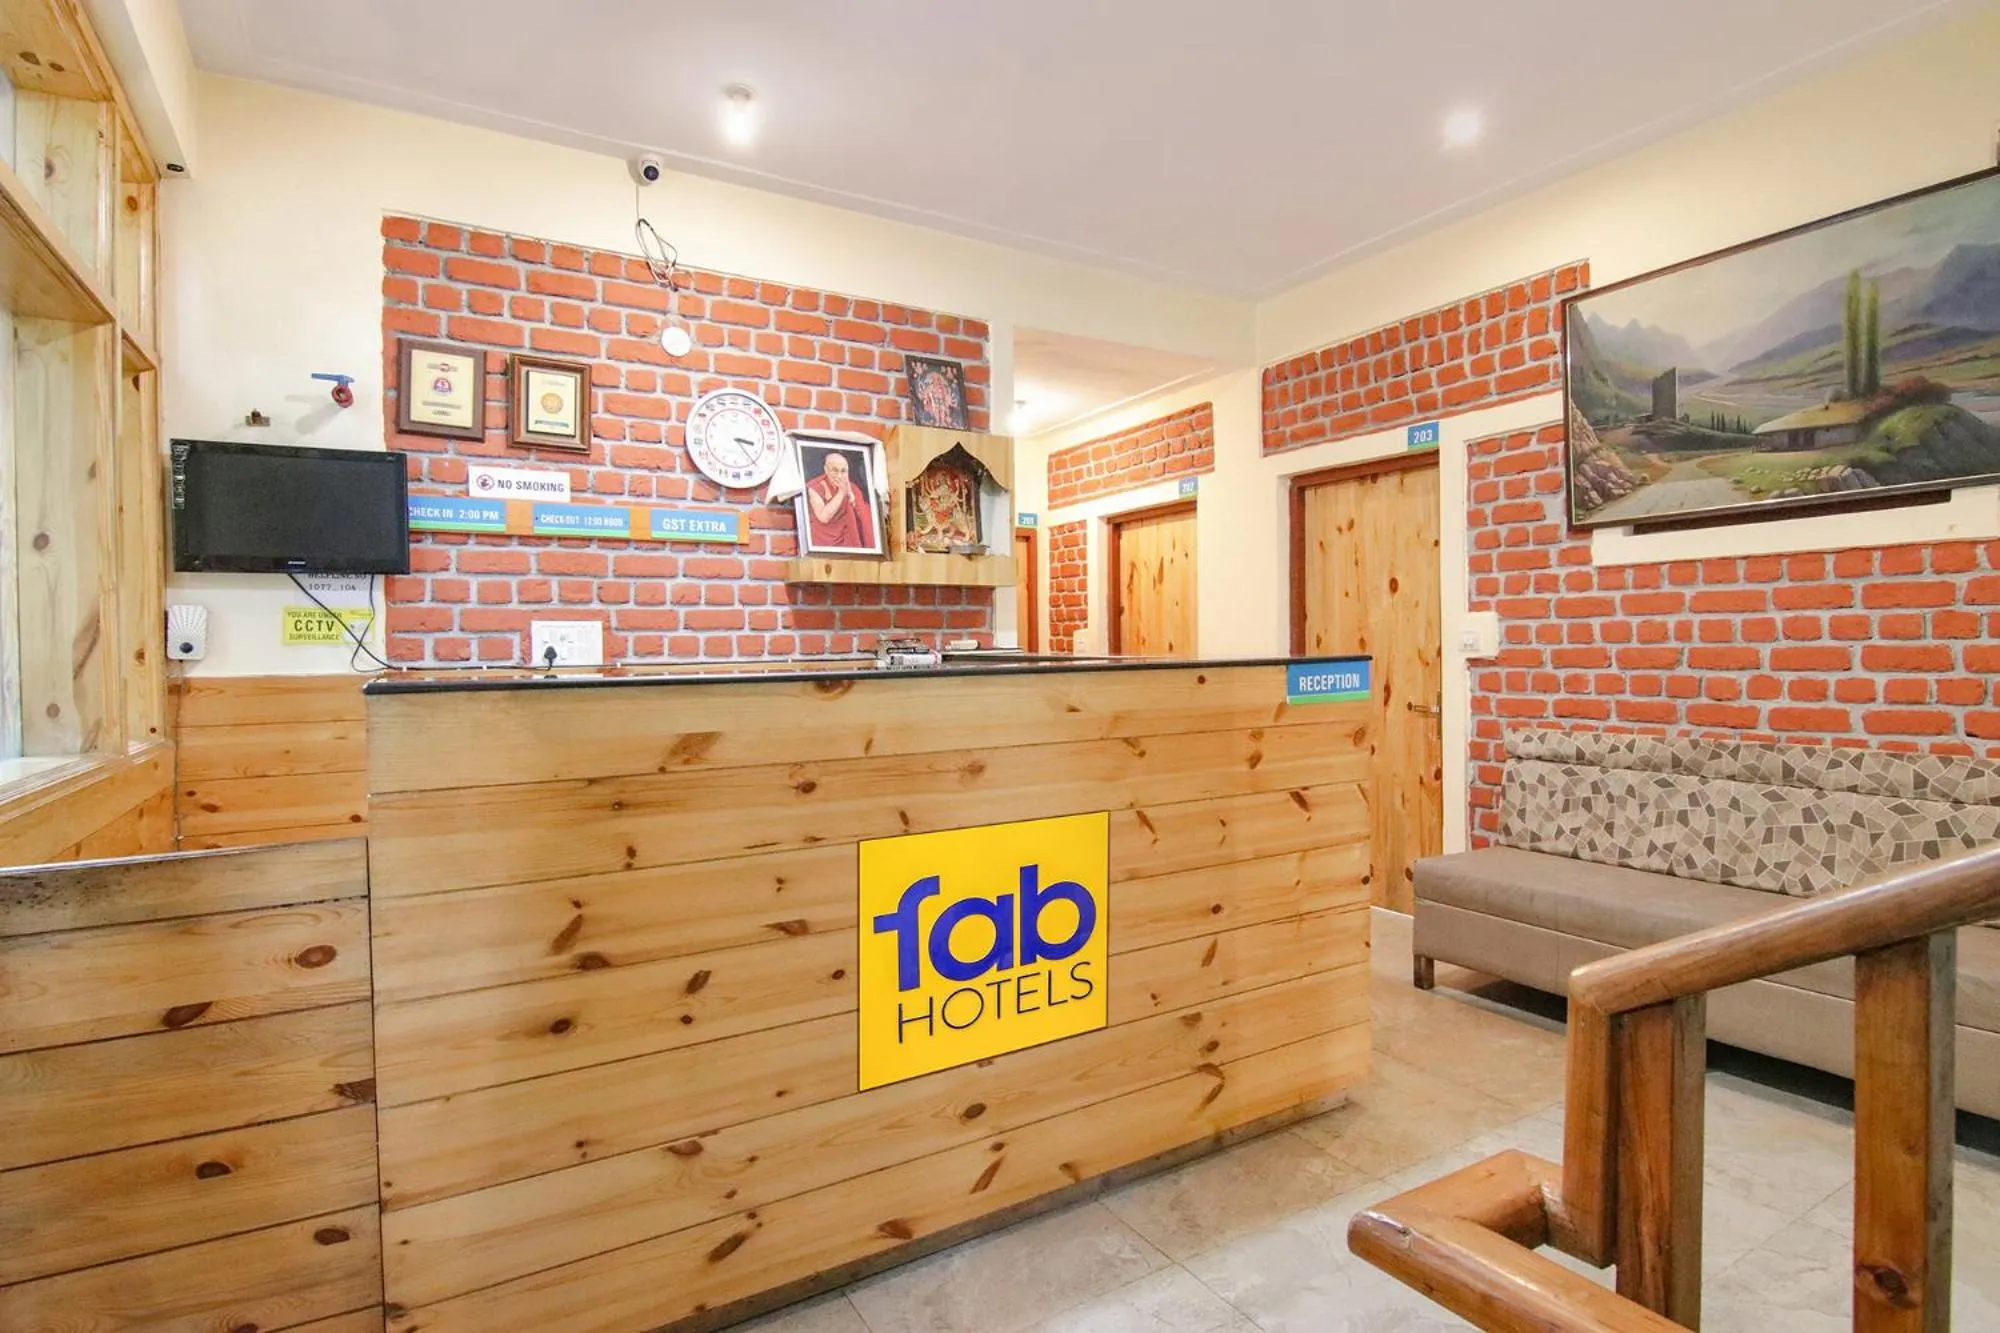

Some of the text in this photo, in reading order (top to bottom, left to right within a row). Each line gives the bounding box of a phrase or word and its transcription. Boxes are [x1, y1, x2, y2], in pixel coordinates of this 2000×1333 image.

[1414, 429, 1432, 443] 203
[497, 479, 564, 492] NO SMOKING
[459, 509, 480, 519] 2:00
[482, 510, 499, 520] PM
[662, 518, 727, 533] GST EXTRA
[294, 619, 334, 632] CCTV
[1299, 672, 1360, 692] RECEPTION
[873, 863, 1097, 992] fab
[898, 961, 1093, 1044] HOTELS
